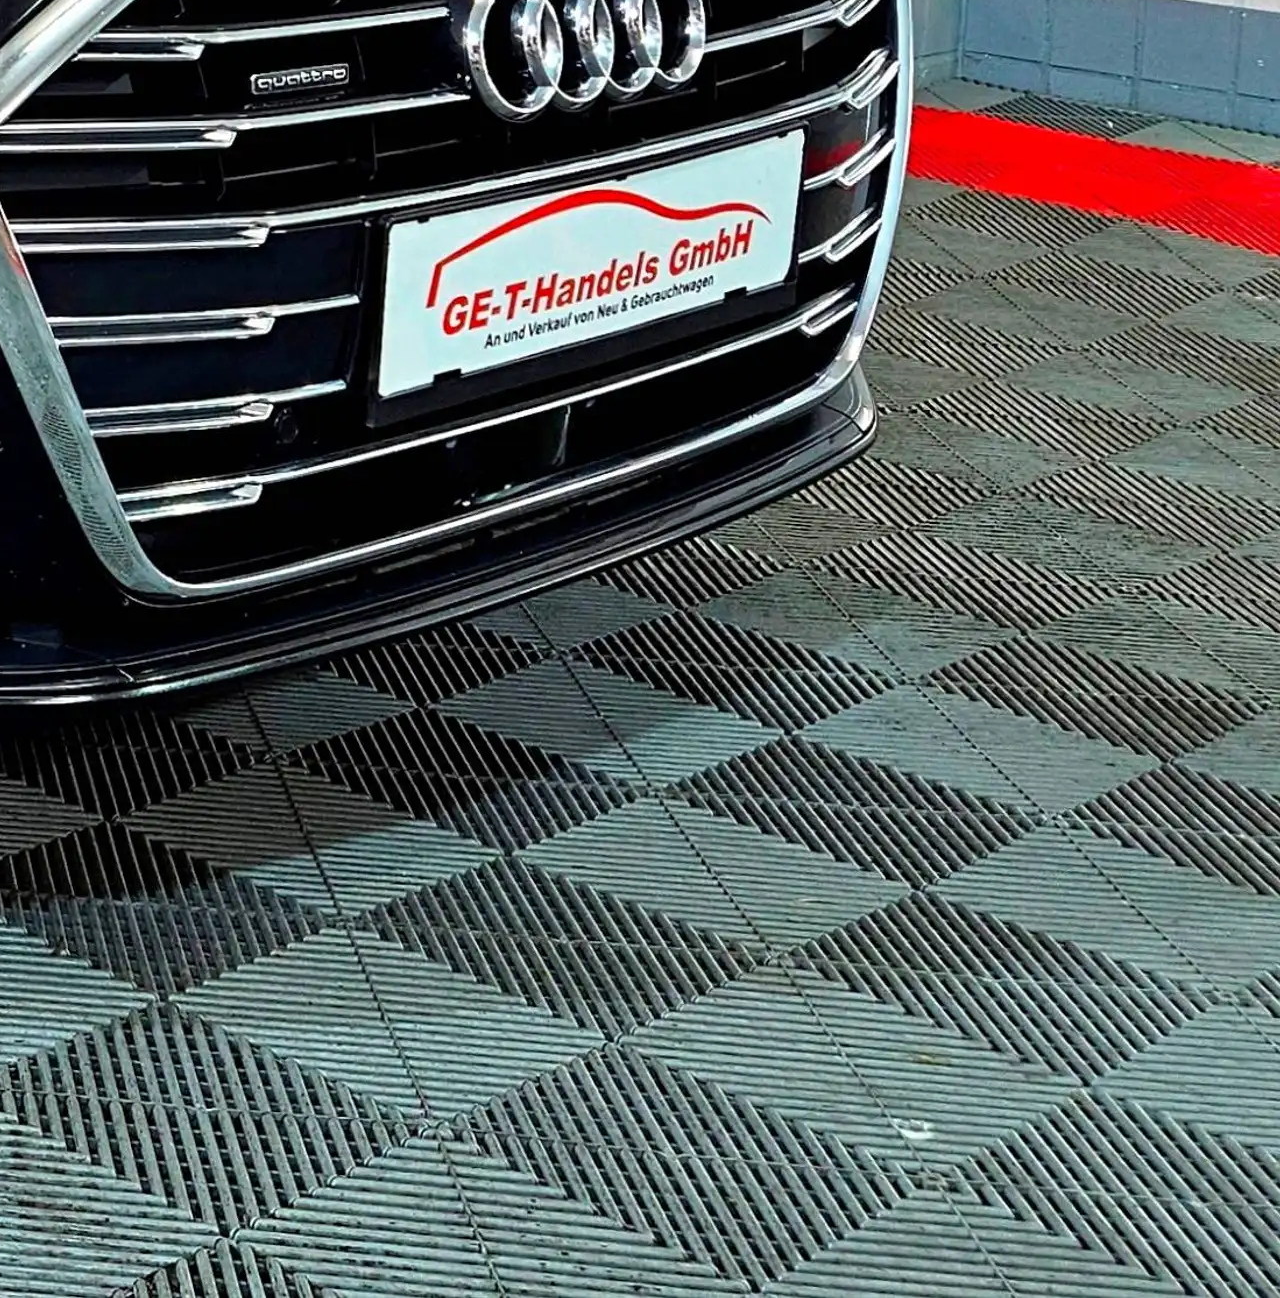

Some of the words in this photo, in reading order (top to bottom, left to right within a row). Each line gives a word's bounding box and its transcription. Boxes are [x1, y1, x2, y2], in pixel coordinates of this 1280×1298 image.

[257, 68, 346, 91] quattro
[442, 250, 660, 336] GE-T-Handels
[668, 219, 754, 277] GmbH
[483, 333, 502, 350] An
[503, 324, 526, 343] und
[527, 311, 573, 337] Verkauf
[574, 310, 594, 324] von
[596, 303, 619, 319] Neu
[620, 298, 628, 312] &
[631, 275, 715, 311] Gebrauchtwagen
